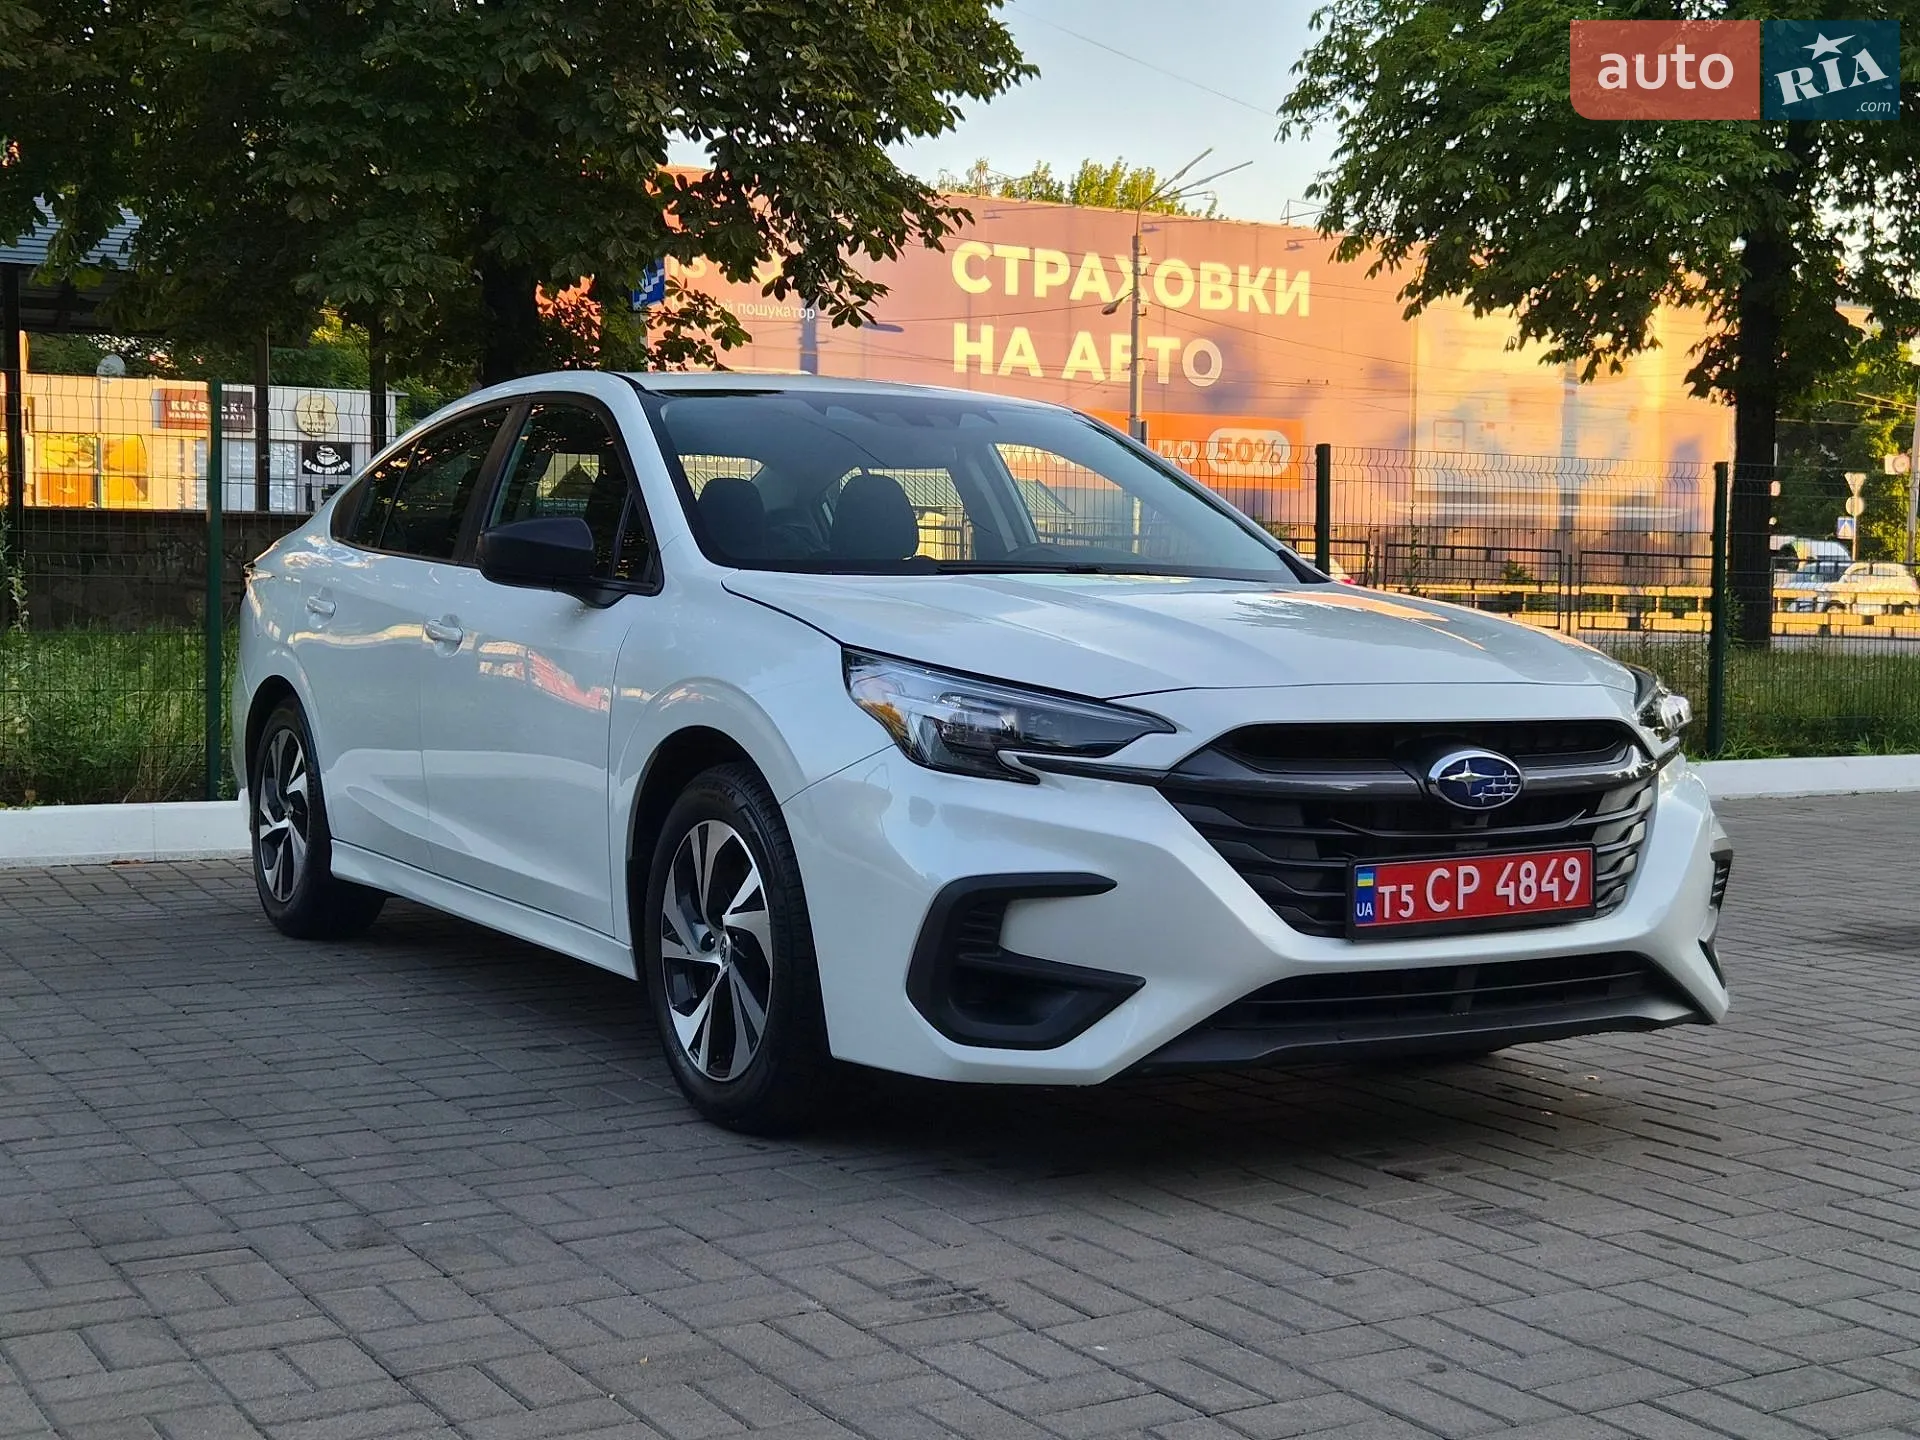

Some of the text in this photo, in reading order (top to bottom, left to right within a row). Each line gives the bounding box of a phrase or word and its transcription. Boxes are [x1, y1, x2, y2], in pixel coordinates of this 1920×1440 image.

[951, 240, 1311, 317] СТРАХОВКИ
[737, 302, 816, 321] пошукатор
[953, 321, 1223, 387] НА АВТО
[1217, 436, 1282, 468] 50%
[1356, 901, 1374, 917] UA
[1378, 856, 1582, 919] T5 CP 4849
